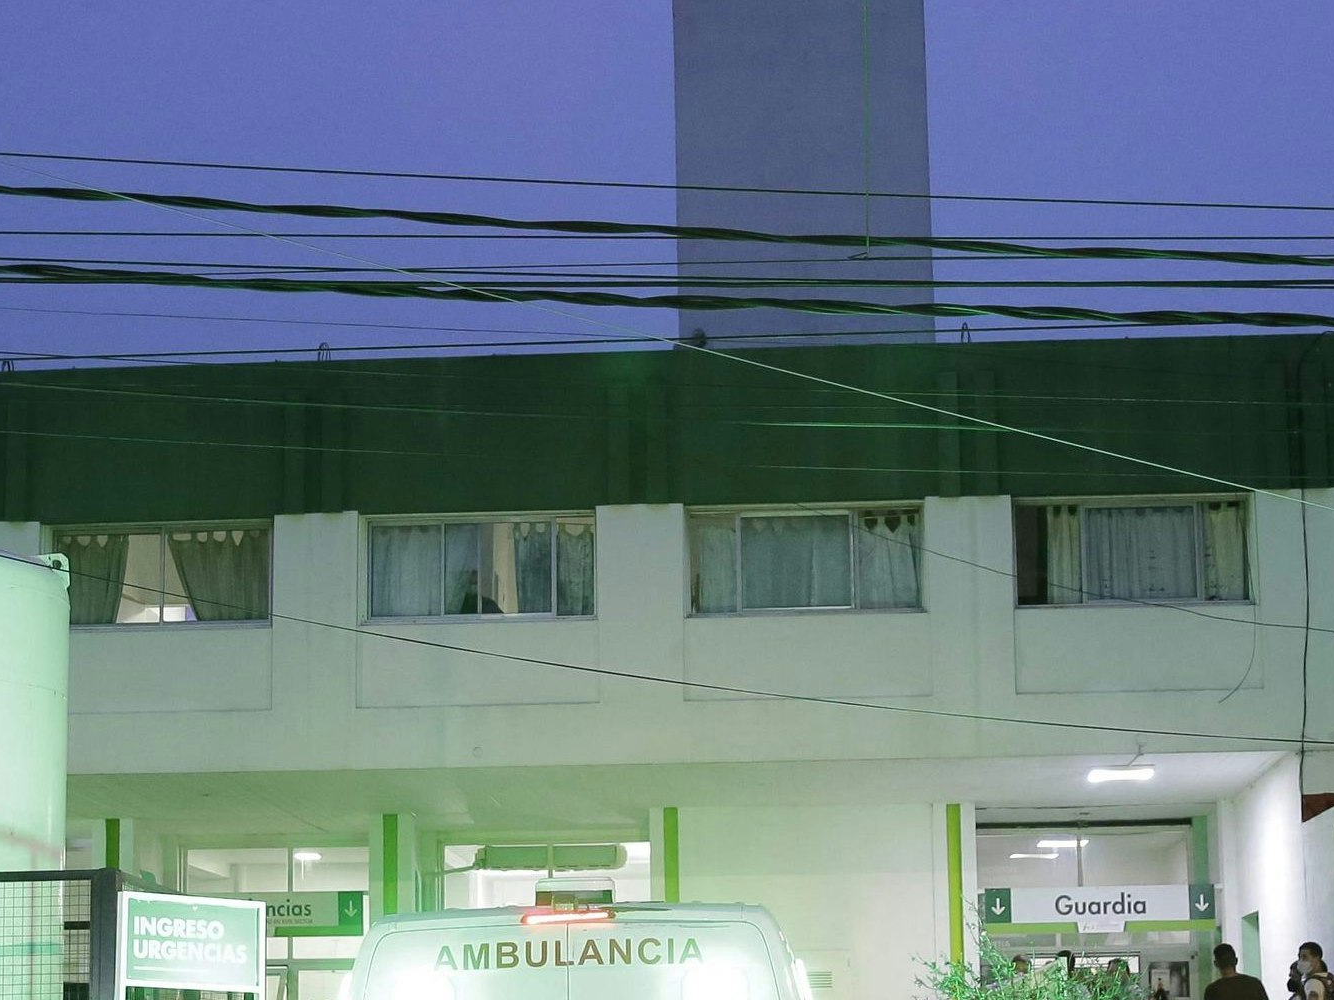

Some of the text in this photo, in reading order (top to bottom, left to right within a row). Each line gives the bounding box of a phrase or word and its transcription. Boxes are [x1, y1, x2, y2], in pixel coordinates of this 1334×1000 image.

[267, 899, 312, 917] ncias
[1055, 892, 1146, 915] Guardia
[134, 915, 224, 940] INGRESO
[133, 939, 247, 964] URGENCIAS
[434, 937, 704, 970] AMBULANCIA
